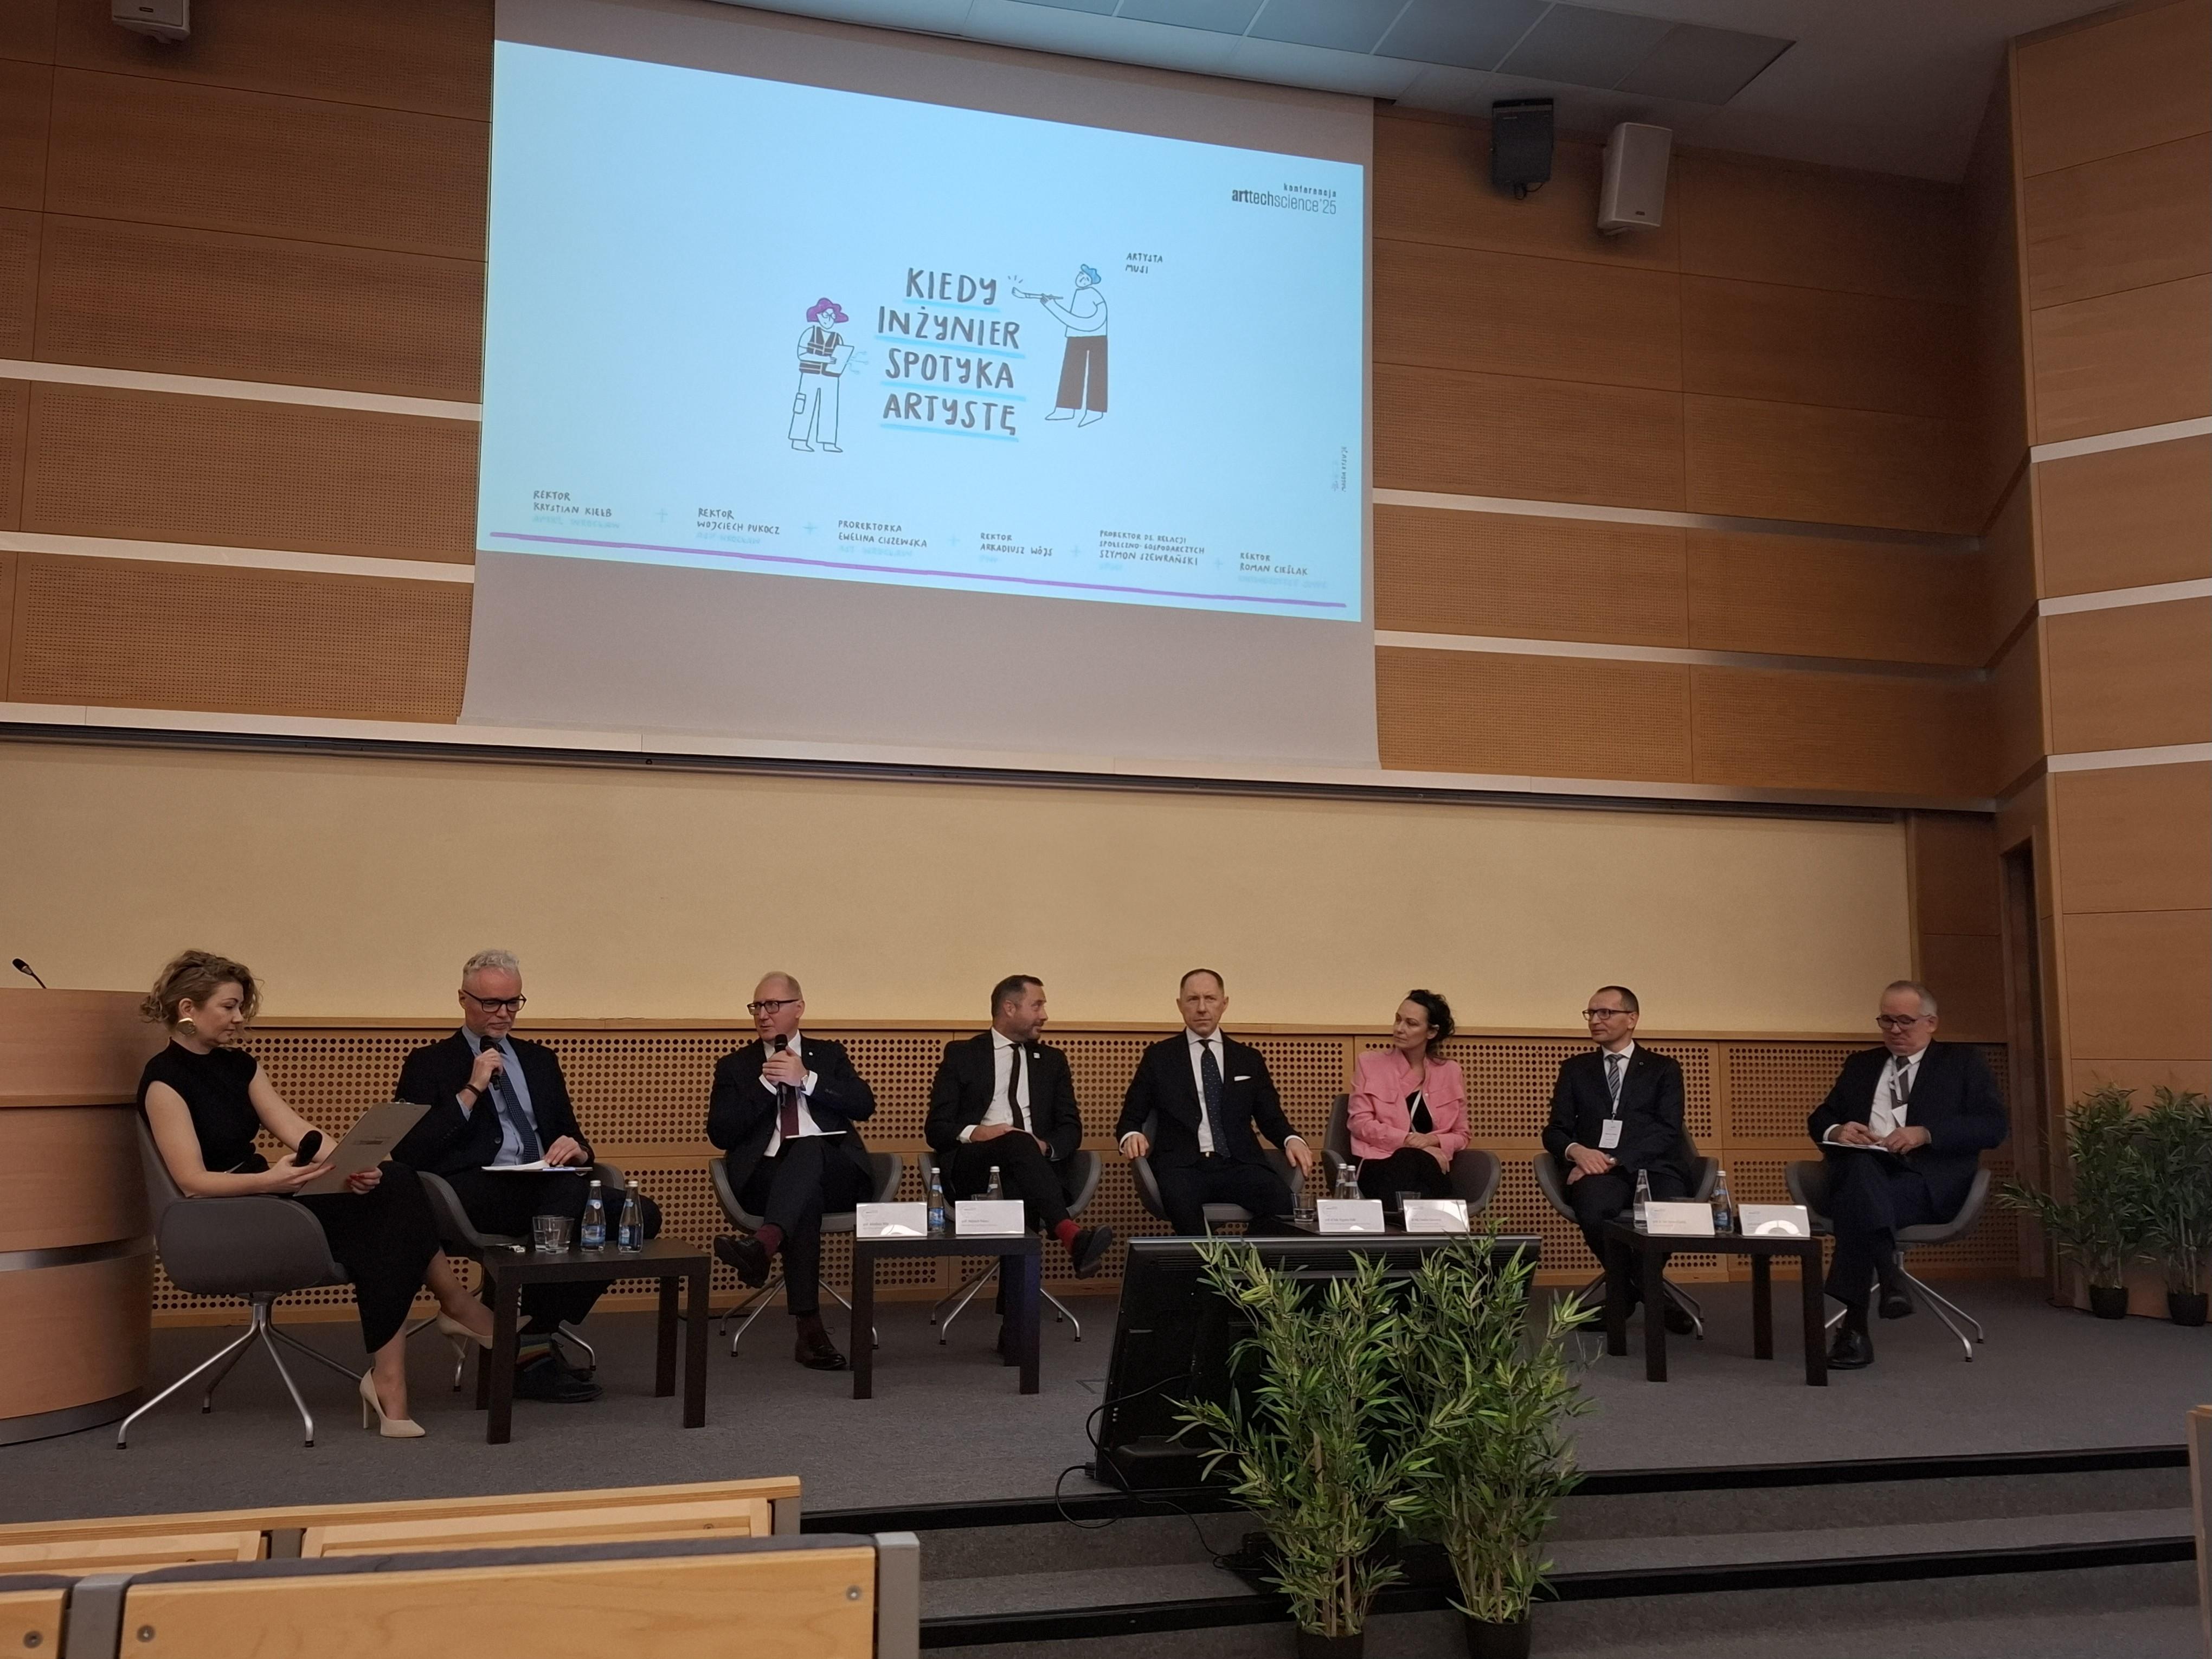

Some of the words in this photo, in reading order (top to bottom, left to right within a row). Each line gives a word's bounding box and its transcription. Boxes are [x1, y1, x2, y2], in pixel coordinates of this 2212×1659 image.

[1283, 183, 1336, 198] konferencja
[1126, 252, 1163, 263] ARTYSTA
[1125, 264, 1148, 274] MUSI
[906, 267, 997, 305] KIEDY
[878, 306, 1020, 350] INŻYNIER
[885, 348, 1014, 389] SPOTYKA
[883, 391, 1016, 435] ARTYSTĘ
[533, 490, 571, 501] REKTOR
[533, 501, 580, 514] KRYSTIAN
[698, 507, 735, 520] REKTOR
[697, 520, 744, 532] WOJCIECH
[747, 523, 780, 535] PUKOCZ
[838, 519, 902, 532] PROREKTORKA
[838, 531, 874, 543] EWELINA
[980, 532, 1013, 542] REKTOR
[1157, 535, 1187, 544] RELACJI
[980, 543, 1025, 555] ARKADIUSZ
[1030, 545, 1053, 557] WÓJS
[1099, 549, 1136, 560] SZYMON
[1240, 552, 1271, 562] REKTOR
[1239, 562, 1270, 573] ROMAN
[1274, 564, 1308, 576] CIEŚLAK
